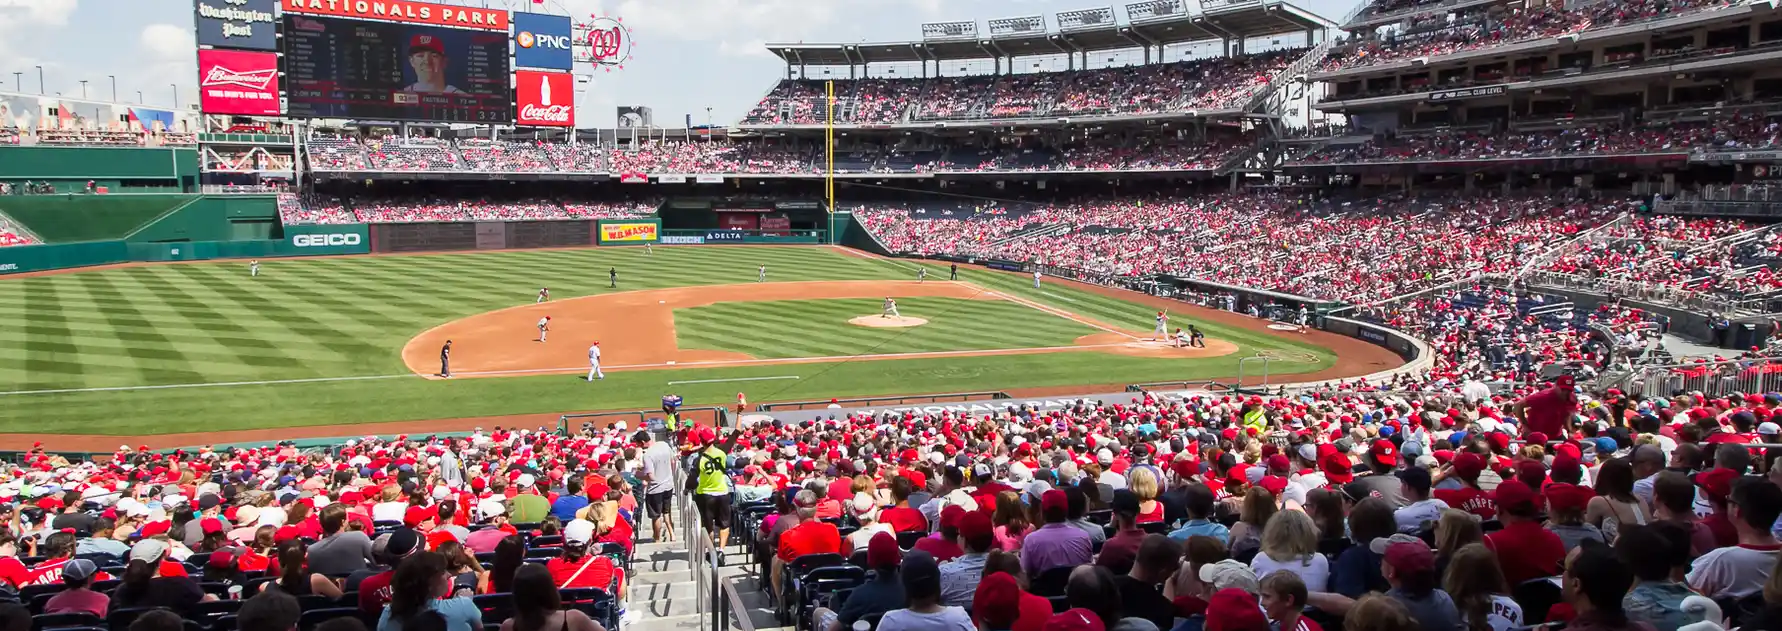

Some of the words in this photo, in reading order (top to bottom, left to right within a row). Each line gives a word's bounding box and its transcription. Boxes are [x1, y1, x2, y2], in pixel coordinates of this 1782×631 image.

[199, 2, 273, 22] Washington
[291, 0, 430, 18] NATIONALS
[442, 8, 497, 24] PARK
[222, 22, 252, 38] Post
[536, 34, 570, 49] PNC
[208, 70, 270, 82] Budweiser
[520, 103, 571, 122] Coca-Cola
[294, 234, 360, 246] GEICO
[1462, 496, 1496, 511] HARPE
